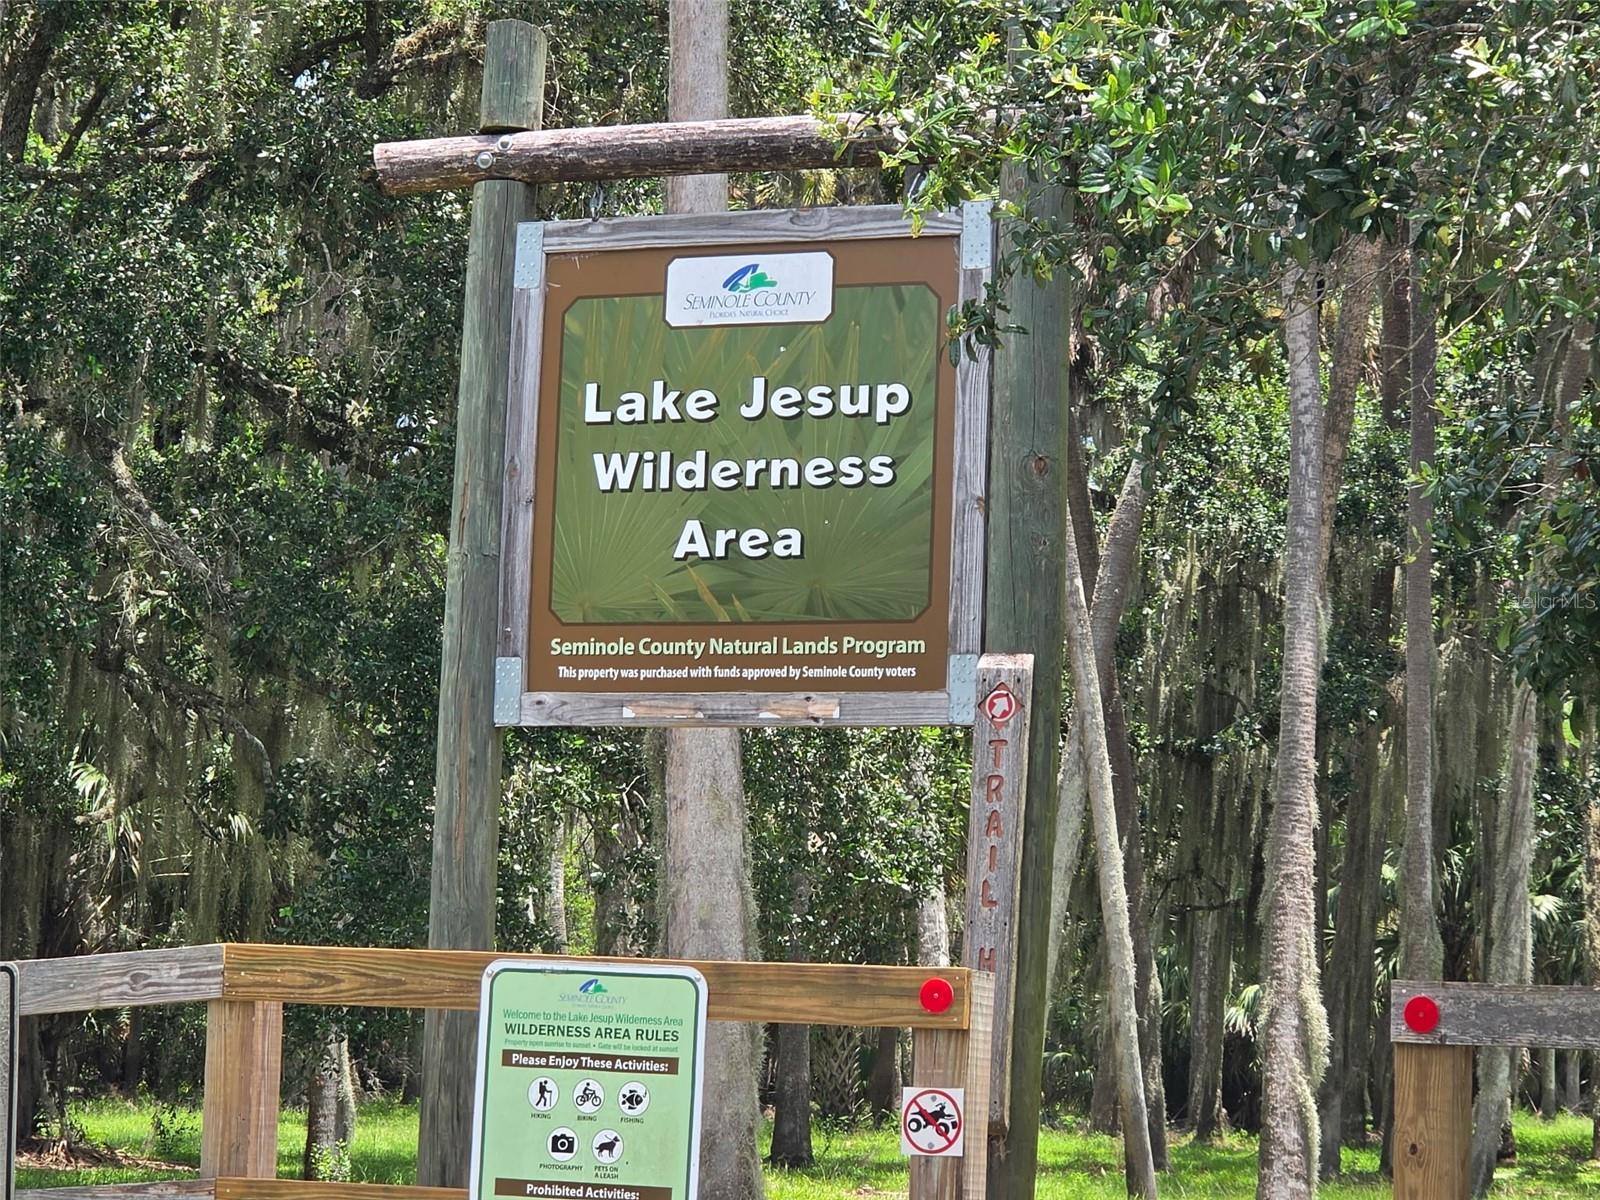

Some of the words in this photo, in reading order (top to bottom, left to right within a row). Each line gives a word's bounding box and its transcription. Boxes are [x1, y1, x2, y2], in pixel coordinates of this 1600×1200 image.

[683, 293, 750, 310] SEMINOLE
[754, 291, 816, 307] COUNTY
[739, 309, 764, 317] NATURAL
[584, 380, 718, 423] Lake
[740, 377, 911, 424] Jesup
[593, 450, 896, 491] Wilderness
[673, 519, 804, 559] Area
[551, 637, 635, 656] Seminole
[639, 638, 705, 659] County
[709, 637, 777, 655] Natural
[782, 636, 838, 655] Lands
[843, 637, 926, 658] Program
[558, 666, 577, 678] This
[578, 667, 619, 680] property
[621, 669, 638, 678] was
[640, 666, 688, 680] purchased
[690, 666, 712, 677] with
[714, 666, 740, 677] funds
[742, 666, 787, 680] approved
[789, 666, 801, 680] by
[802, 666, 847, 677] Seminole
[849, 666, 884, 679] County
[885, 667, 916, 677] voters
[981, 739, 1009, 907] TRAIL
[503, 1009, 541, 1020] Welcome
[543, 1011, 552, 1020] to
[553, 1011, 567, 1021] the
[568, 1011, 589, 1022] Lake
[589, 1013, 613, 1024] Jesup
[615, 1013, 662, 1026] Wilderness
[663, 1016, 683, 1026] Area
[504, 1023, 591, 1038] WILDERNESS
[594, 1027, 631, 1040] AREA
[636, 1029, 679, 1042] RULES
[504, 1038, 528, 1047] Property
[529, 1040, 543, 1048] open
[598, 1042, 611, 1050] Gate
[632, 1044, 651, 1052] locked
[511, 1053, 547, 1066] Please
[548, 1055, 579, 1069] Enjoy
[580, 1056, 612, 1069] These
[614, 1058, 668, 1072] Activities:
[539, 1163, 583, 1172] PHOTOGRAPHY
[526, 1183, 584, 1197] Prohibited
[585, 1185, 640, 1200] Activities:
